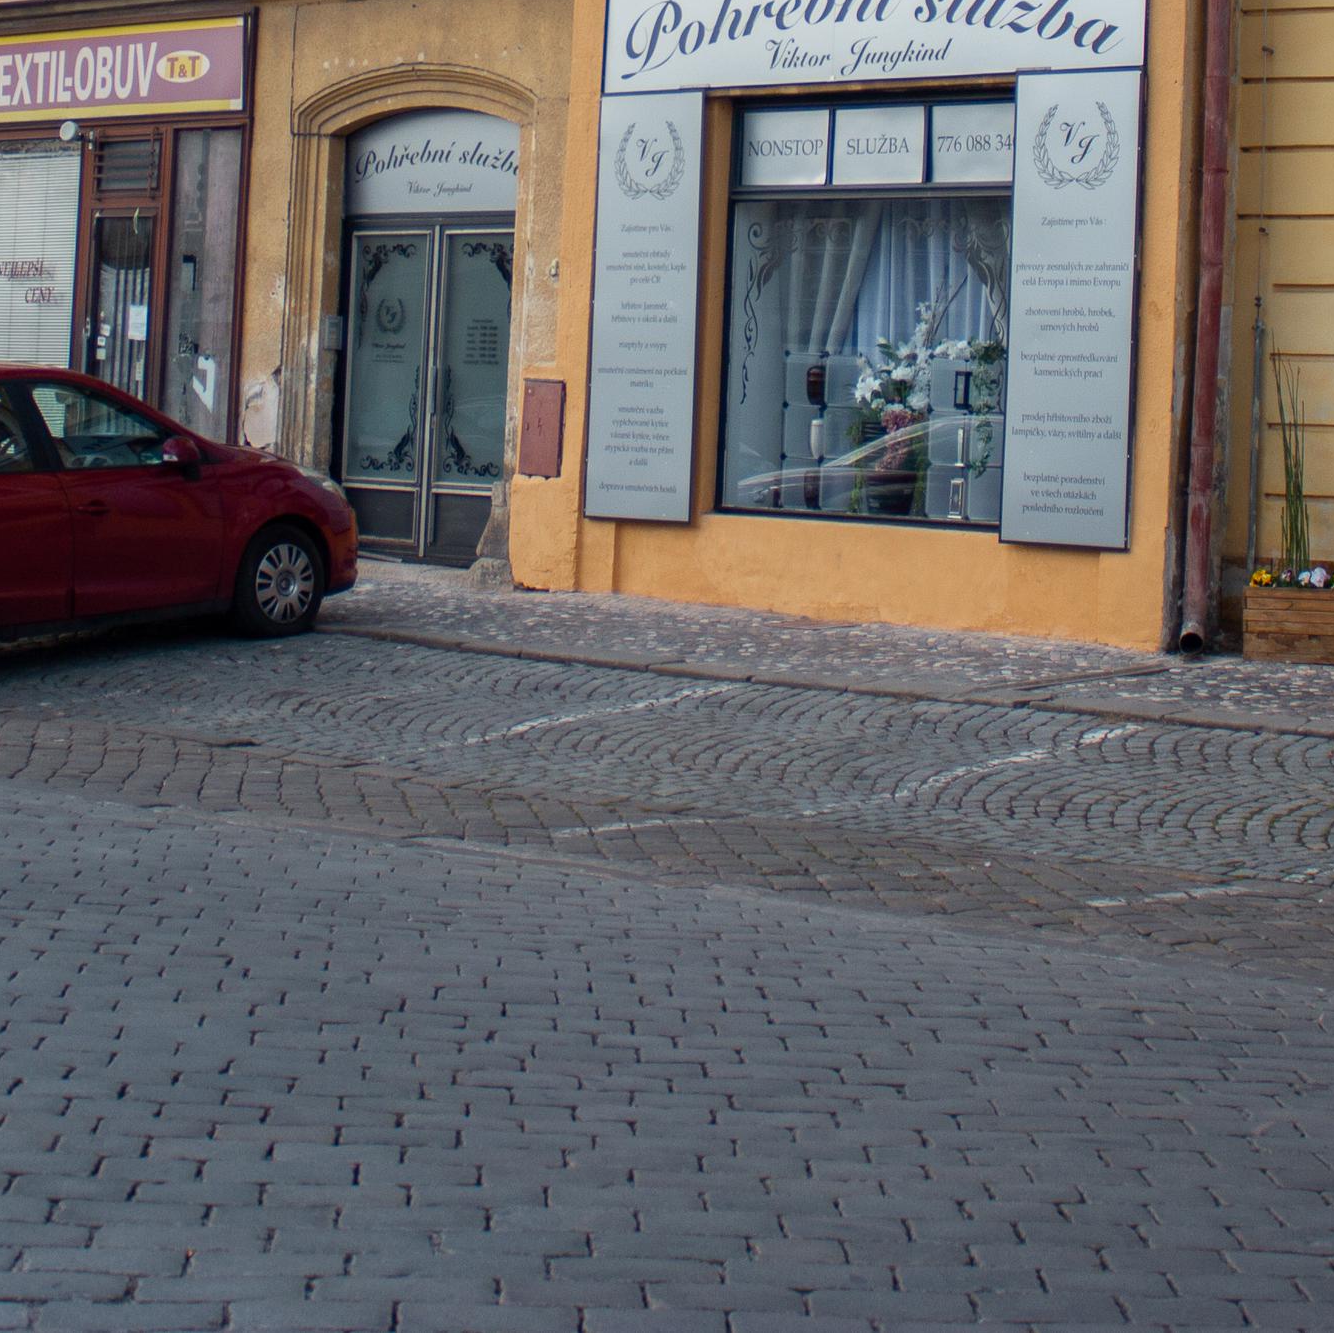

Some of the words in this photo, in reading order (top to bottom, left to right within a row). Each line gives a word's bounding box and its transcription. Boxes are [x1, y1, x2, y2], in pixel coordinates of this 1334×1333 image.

[765, 38, 832, 72] Viktor
[841, 38, 953, 76] Jungkind
[748, 139, 824, 158] NONSTOP
[846, 133, 909, 156] SLUŽBA
[938, 135, 962, 153] 776
[966, 134, 991, 152] 088
[996, 133, 1015, 151] 34
[355, 139, 456, 183] Pohřební
[1038, 277, 1063, 289] Evropa
[1070, 278, 1091, 286] mimo
[1093, 277, 1121, 289] Evropu
[1022, 411, 1046, 424] prodej
